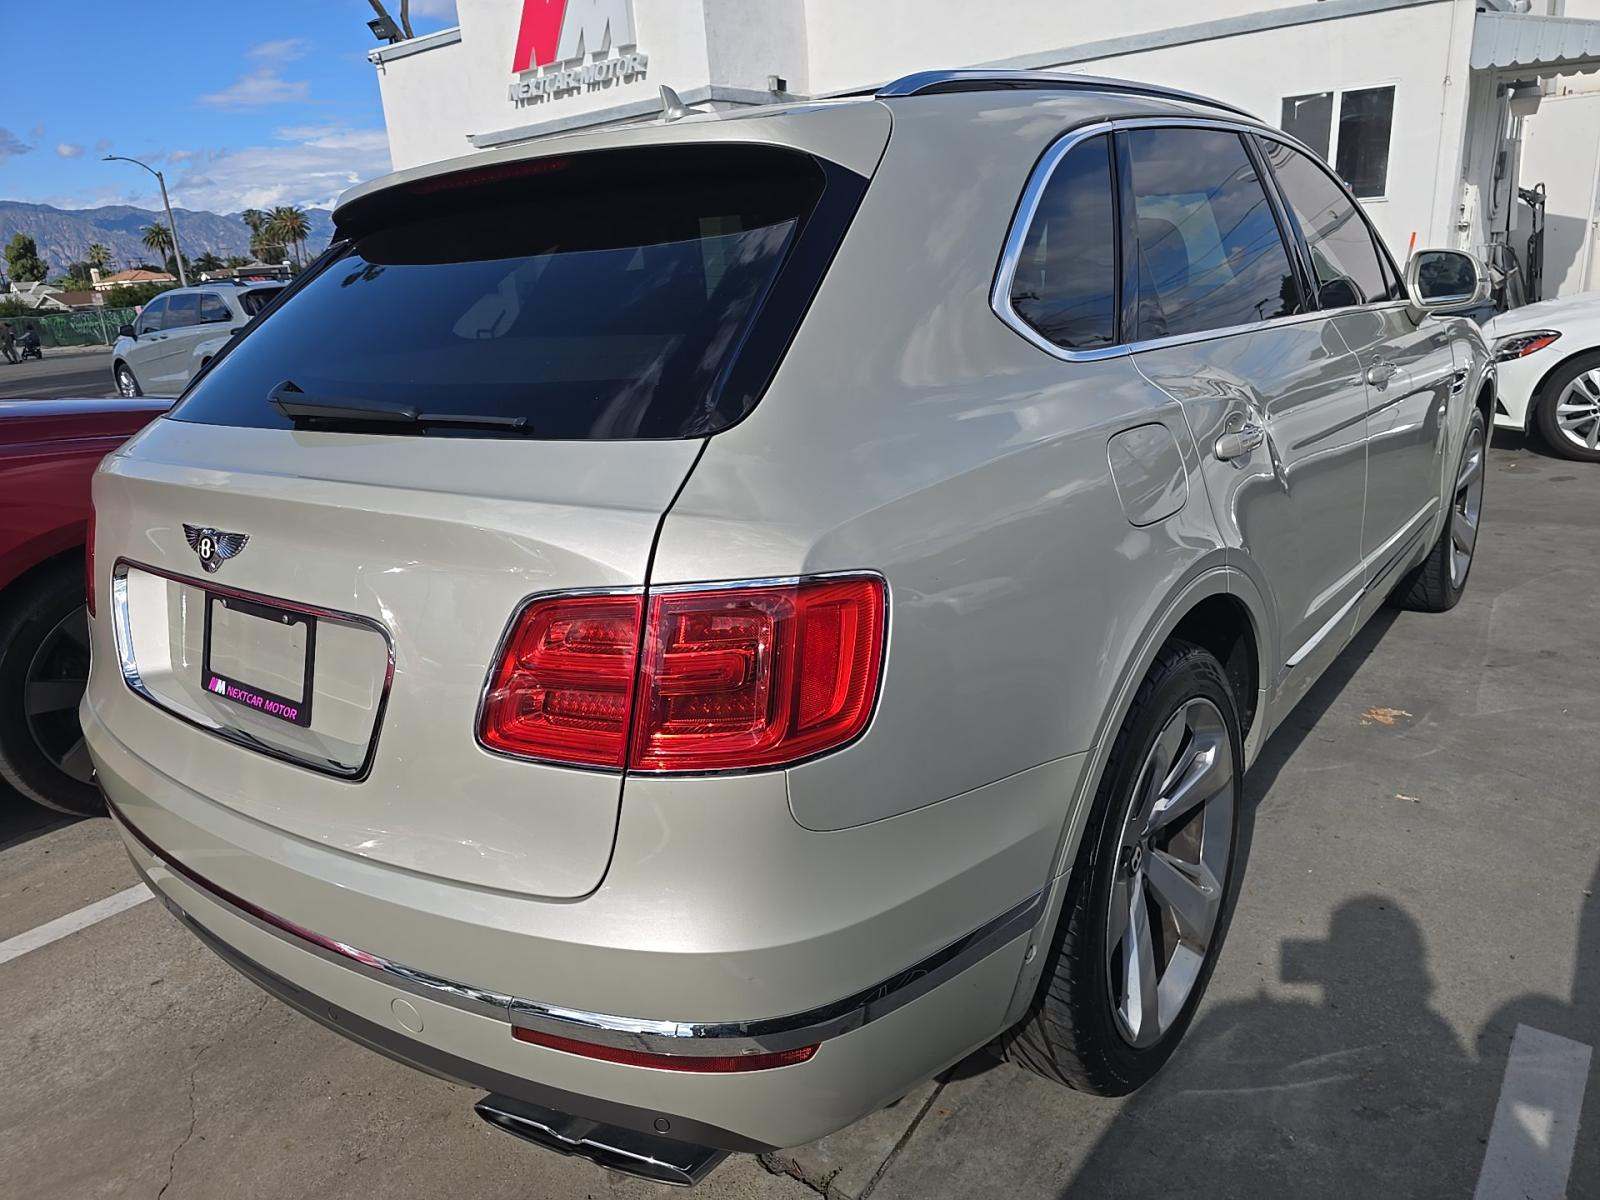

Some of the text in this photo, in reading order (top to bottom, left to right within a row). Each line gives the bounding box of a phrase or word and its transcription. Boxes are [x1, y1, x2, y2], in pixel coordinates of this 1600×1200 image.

[509, 54, 648, 101] NEXTCAR MOTOR
[226, 686, 263, 708] NEXTCAR
[264, 700, 298, 720] MOTOR
